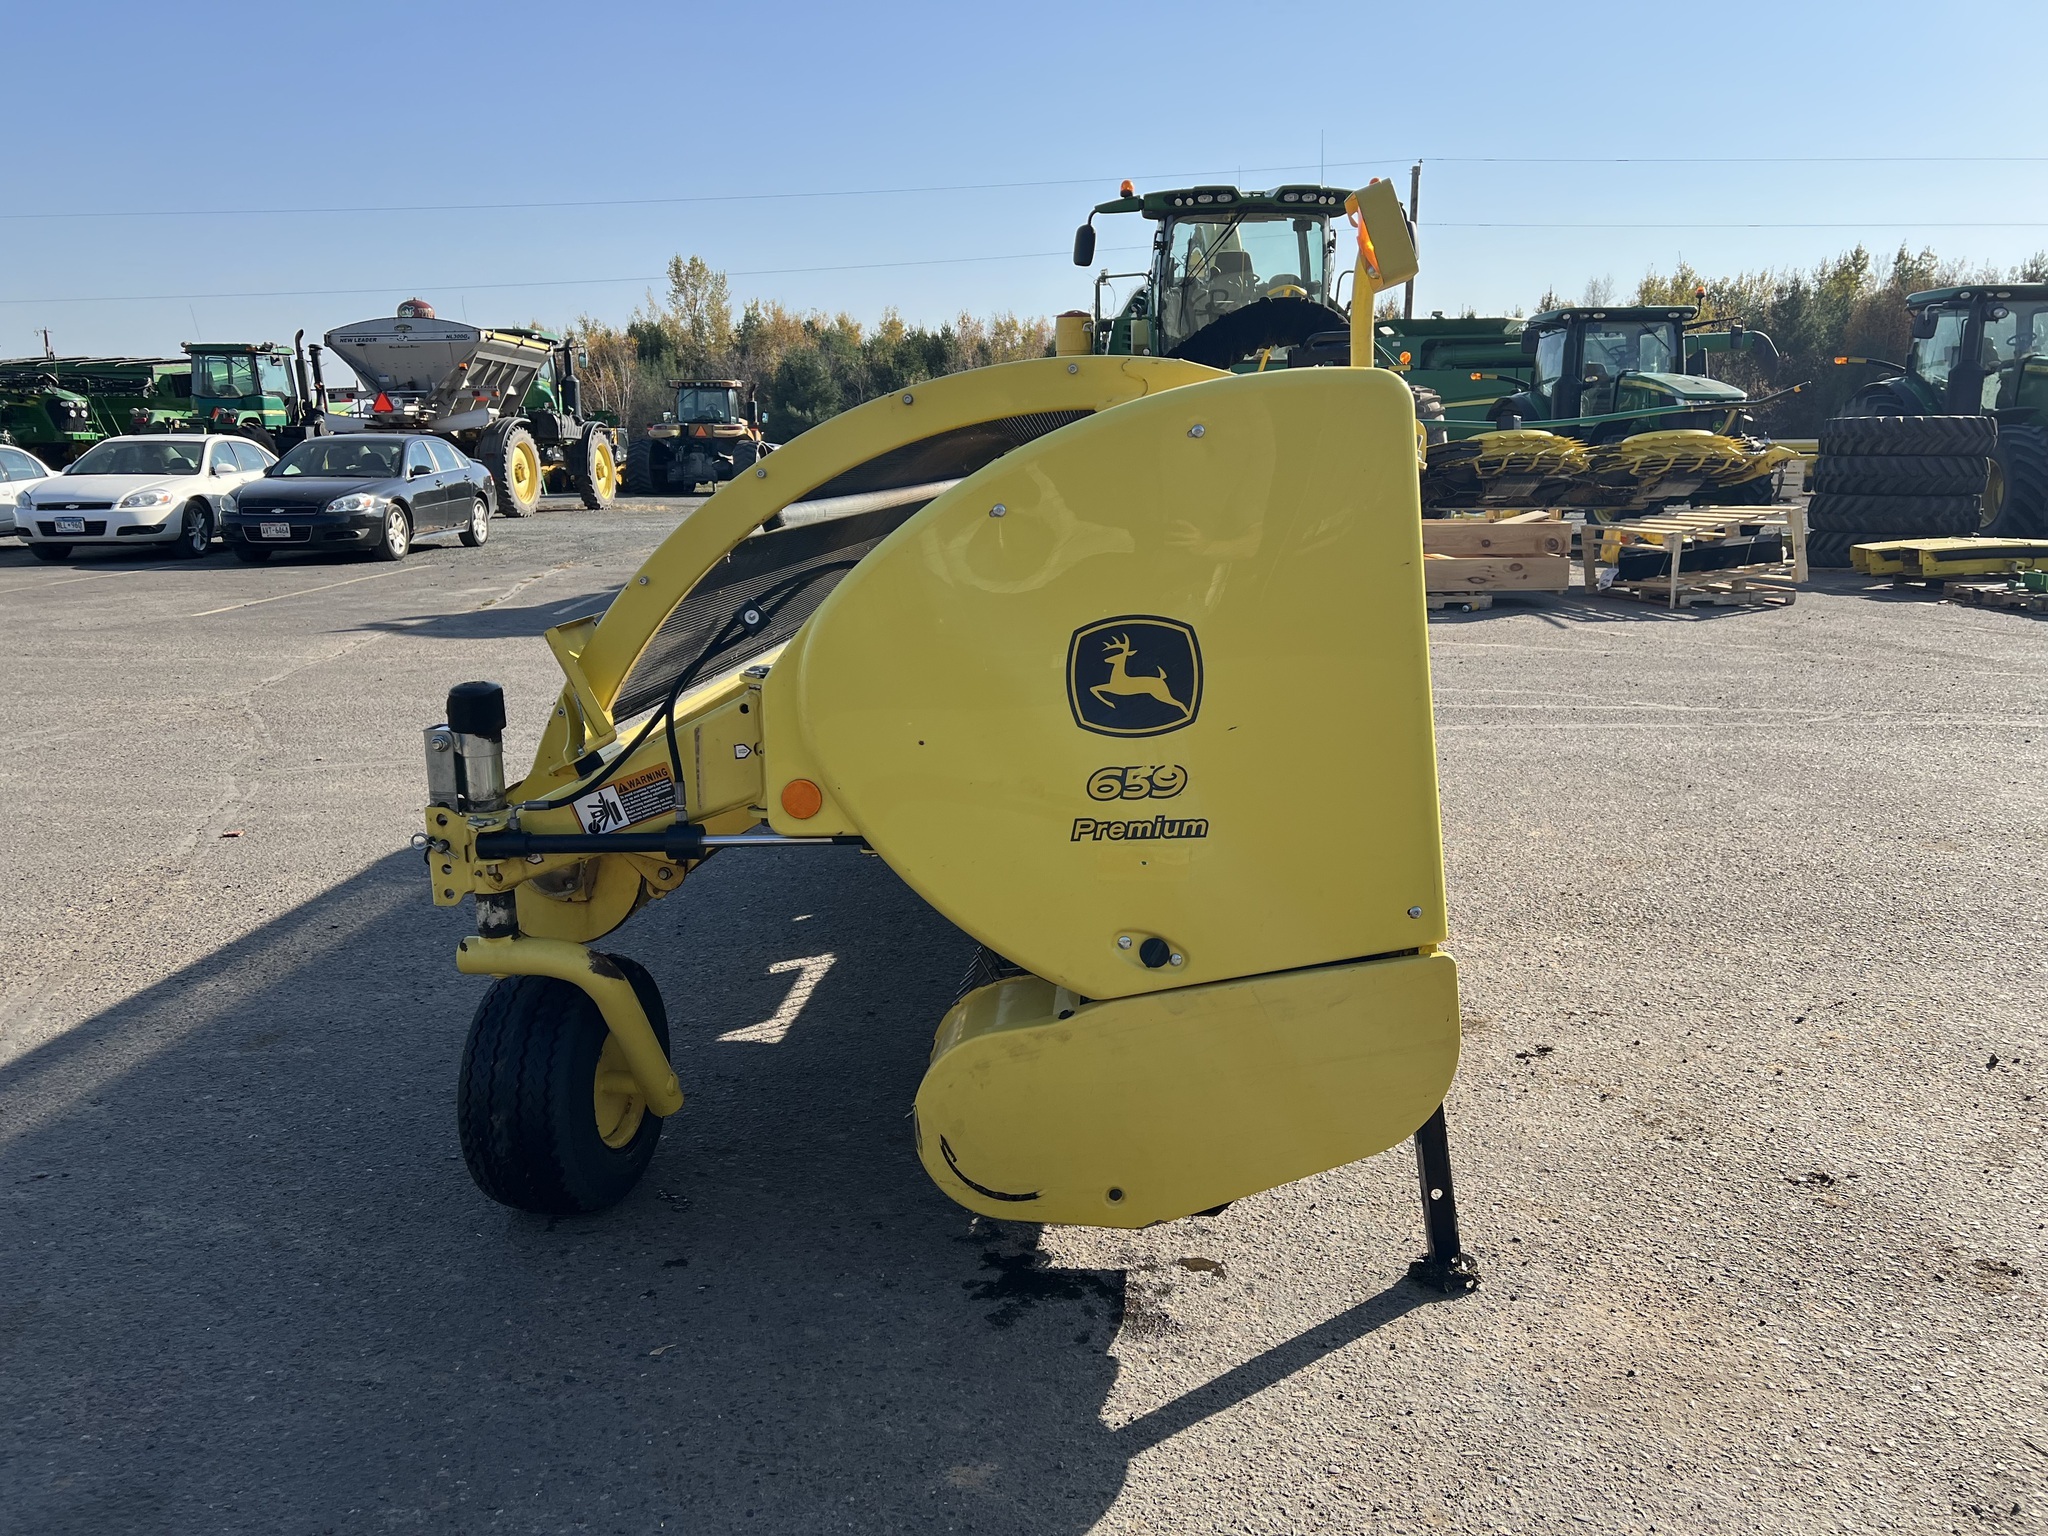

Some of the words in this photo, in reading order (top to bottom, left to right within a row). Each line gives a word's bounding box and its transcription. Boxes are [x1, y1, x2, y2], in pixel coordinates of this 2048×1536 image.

[626, 767, 668, 789] WARNING
[1086, 765, 1188, 801] 659
[1070, 815, 1209, 841] Premium
